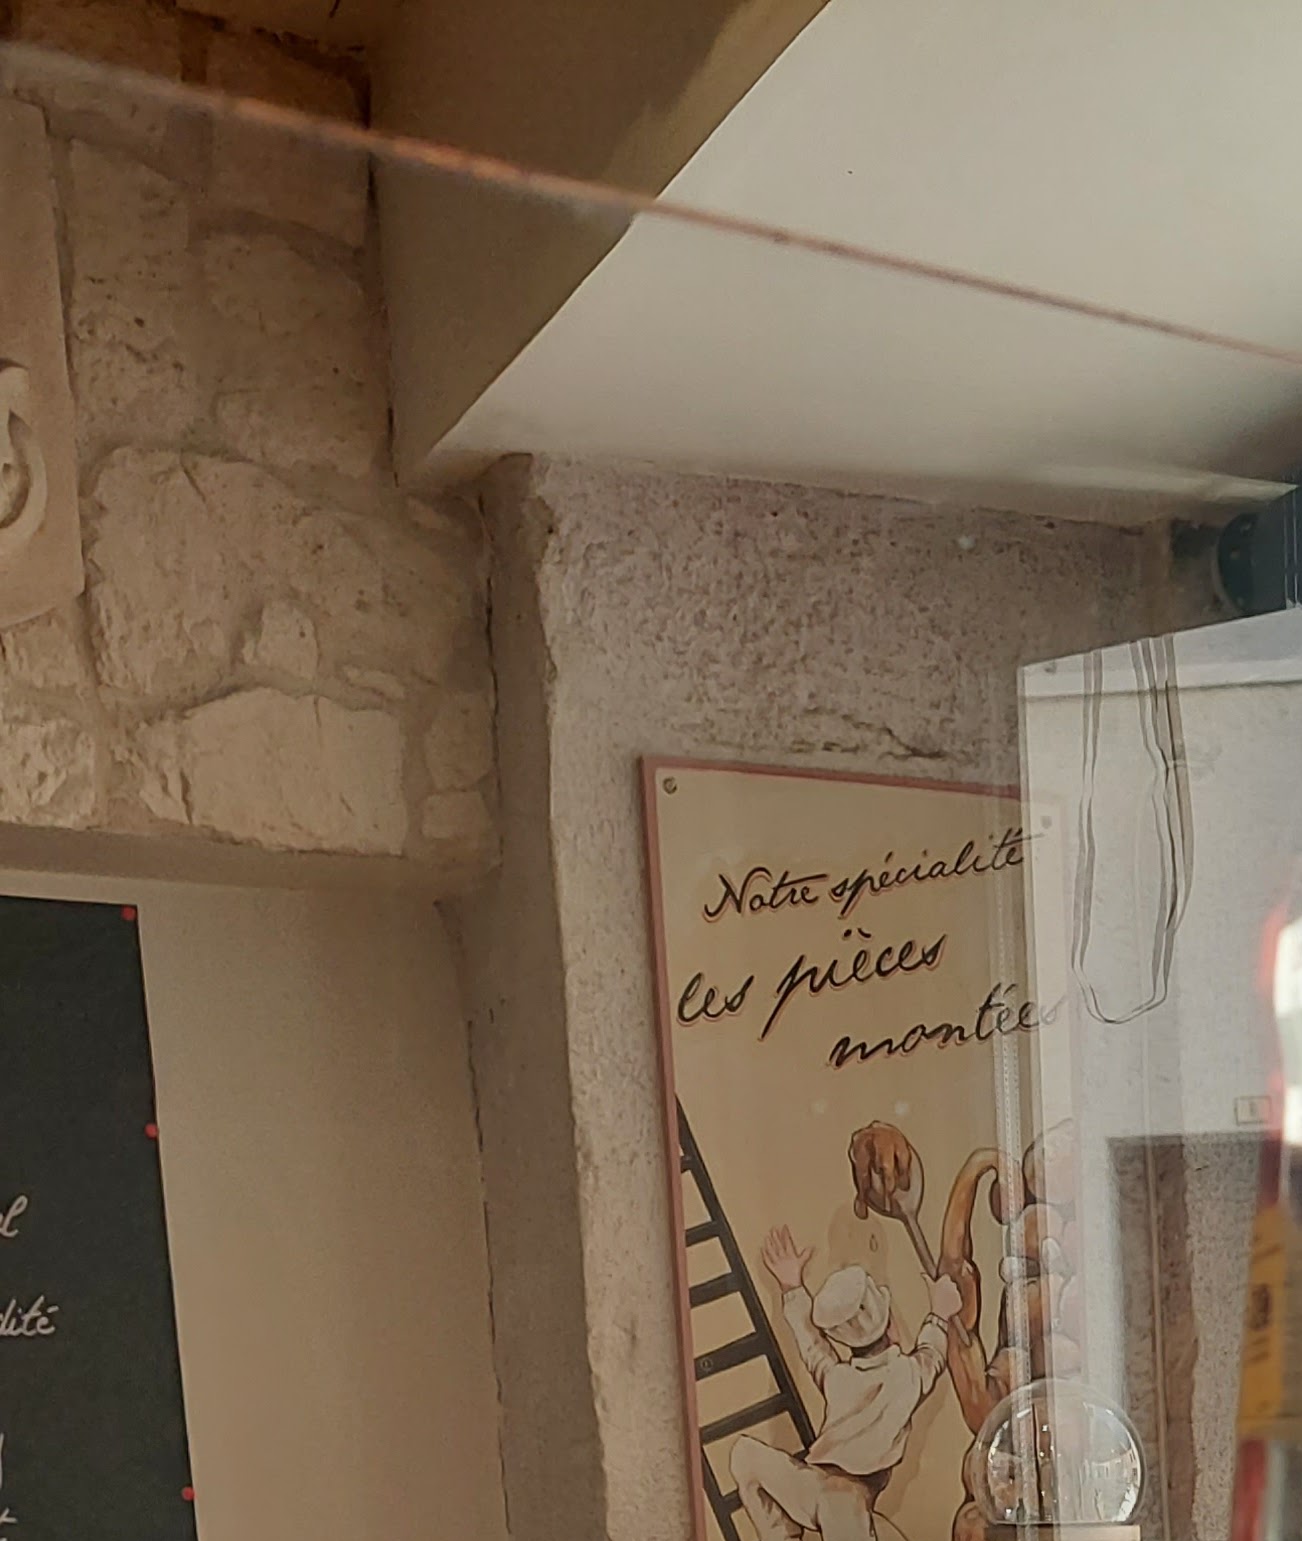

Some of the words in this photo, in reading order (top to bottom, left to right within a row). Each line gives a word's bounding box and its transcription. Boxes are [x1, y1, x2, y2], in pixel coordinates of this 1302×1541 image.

[702, 866, 829, 923] Notre
[830, 827, 1045, 918] spécialité
[677, 972, 755, 1025] les
[760, 928, 948, 1041] pièces
[828, 983, 1064, 1069] montées
